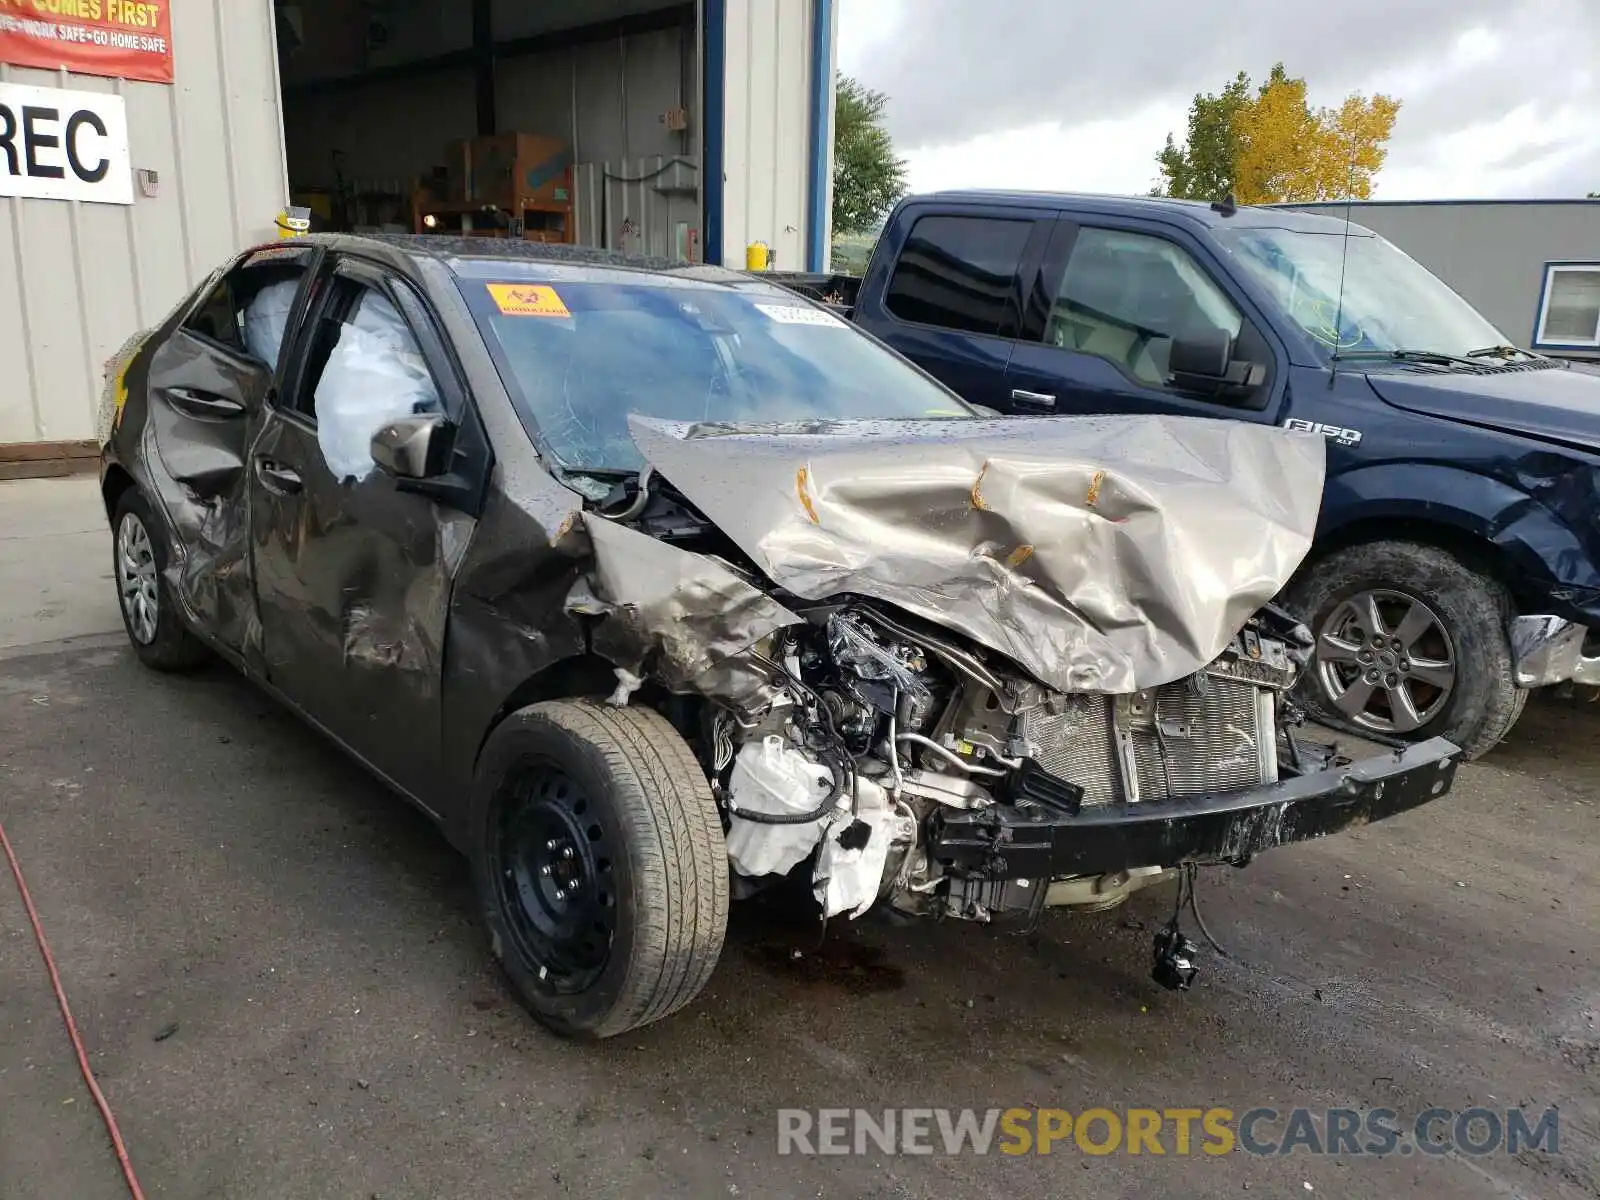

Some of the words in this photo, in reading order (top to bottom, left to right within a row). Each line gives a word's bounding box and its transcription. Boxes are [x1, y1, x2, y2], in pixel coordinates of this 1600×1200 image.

[107, 0, 159, 27] FIRST
[110, 31, 139, 49] HOME
[140, 37, 166, 53] SAFE
